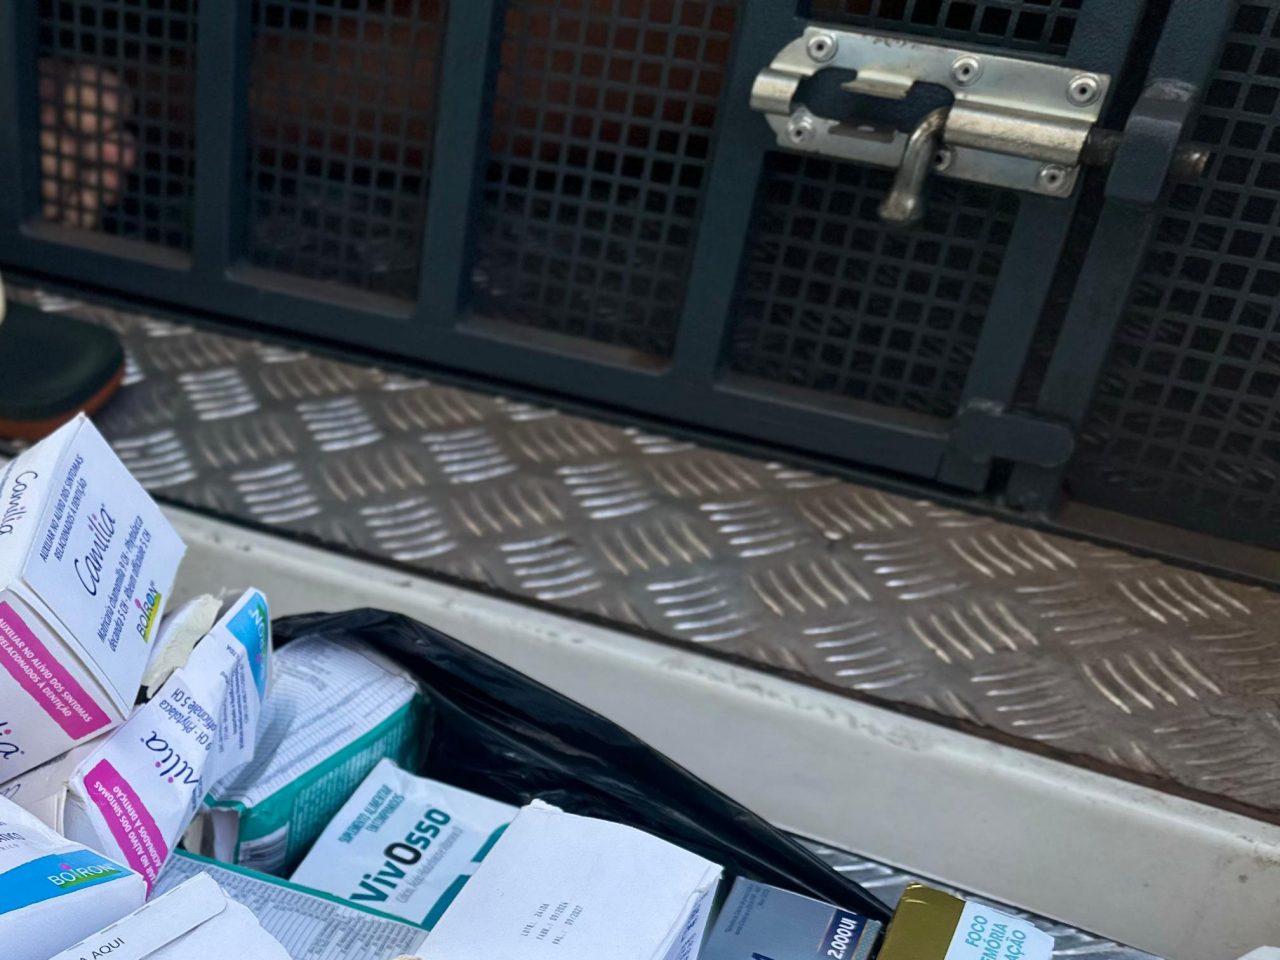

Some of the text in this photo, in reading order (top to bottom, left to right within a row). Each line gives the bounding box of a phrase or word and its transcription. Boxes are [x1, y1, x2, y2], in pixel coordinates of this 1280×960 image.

[74, 507, 116, 597] Camilia
[21, 645, 35, 659] NO
[30, 655, 54, 680] ALÍVIO
[49, 676, 65, 693] DOS
[61, 689, 92, 723] SINTOMAS
[41, 685, 72, 718] DENTIÇÃO
[94, 781, 125, 816] SINTOMAS
[349, 808, 451, 903] VivOsso
[47, 862, 114, 888] BOIRON
[964, 915, 988, 948] FOCO
